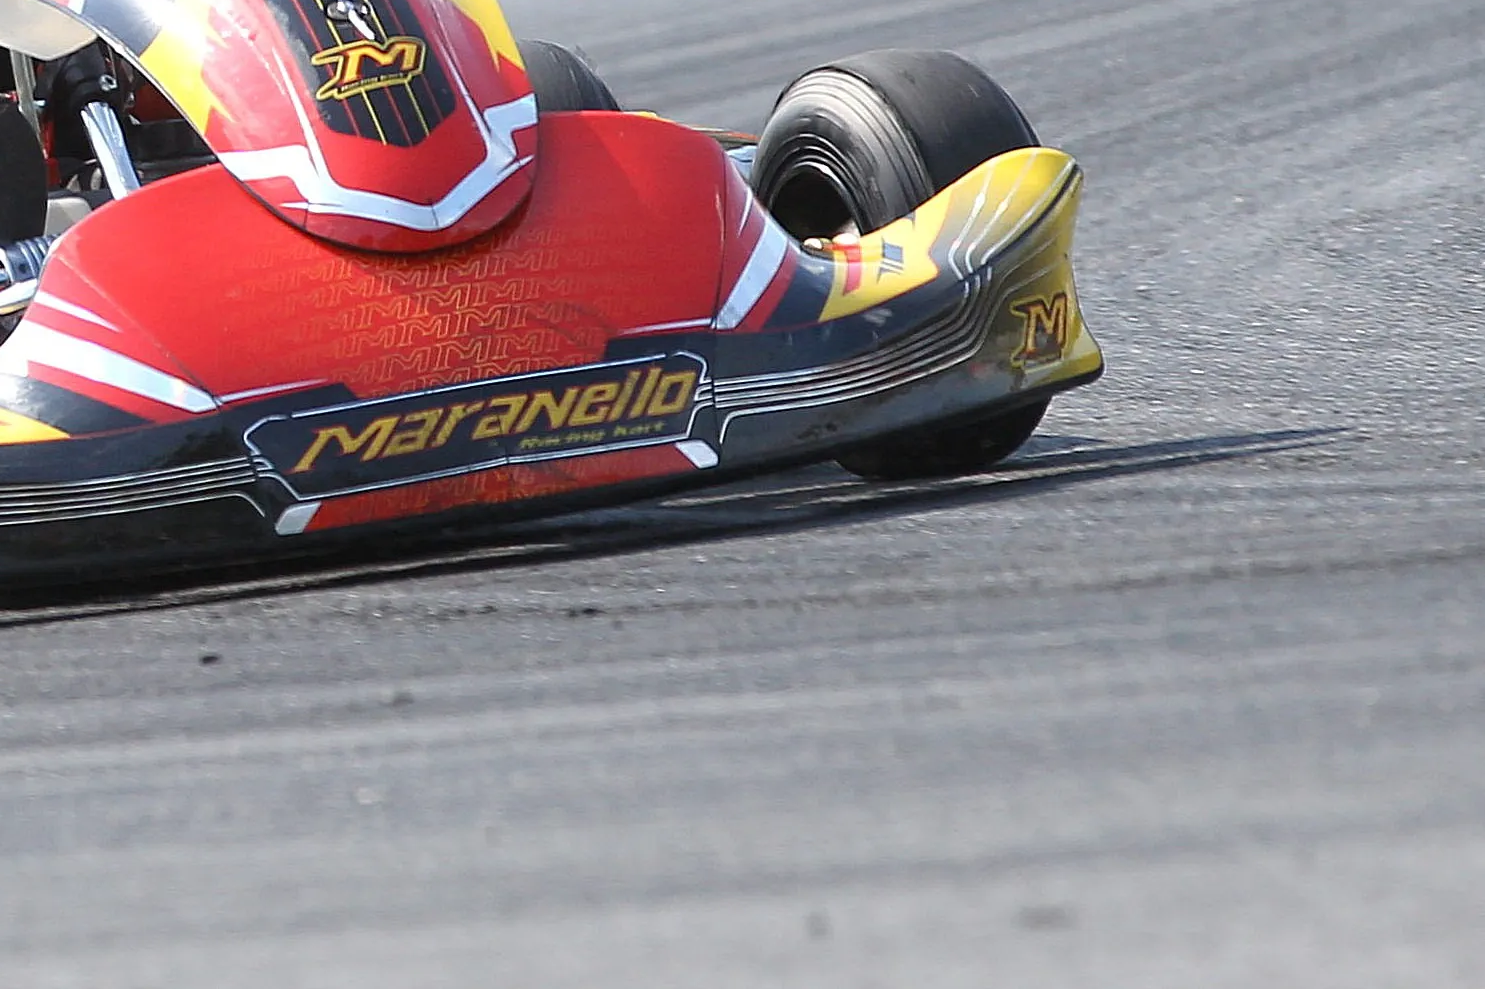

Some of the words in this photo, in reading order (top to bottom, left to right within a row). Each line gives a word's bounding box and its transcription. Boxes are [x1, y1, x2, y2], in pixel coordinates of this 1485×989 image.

[342, 42, 418, 84] M
[1024, 294, 1068, 355] M
[286, 366, 698, 473] Maranello
[612, 420, 665, 437] Kart
